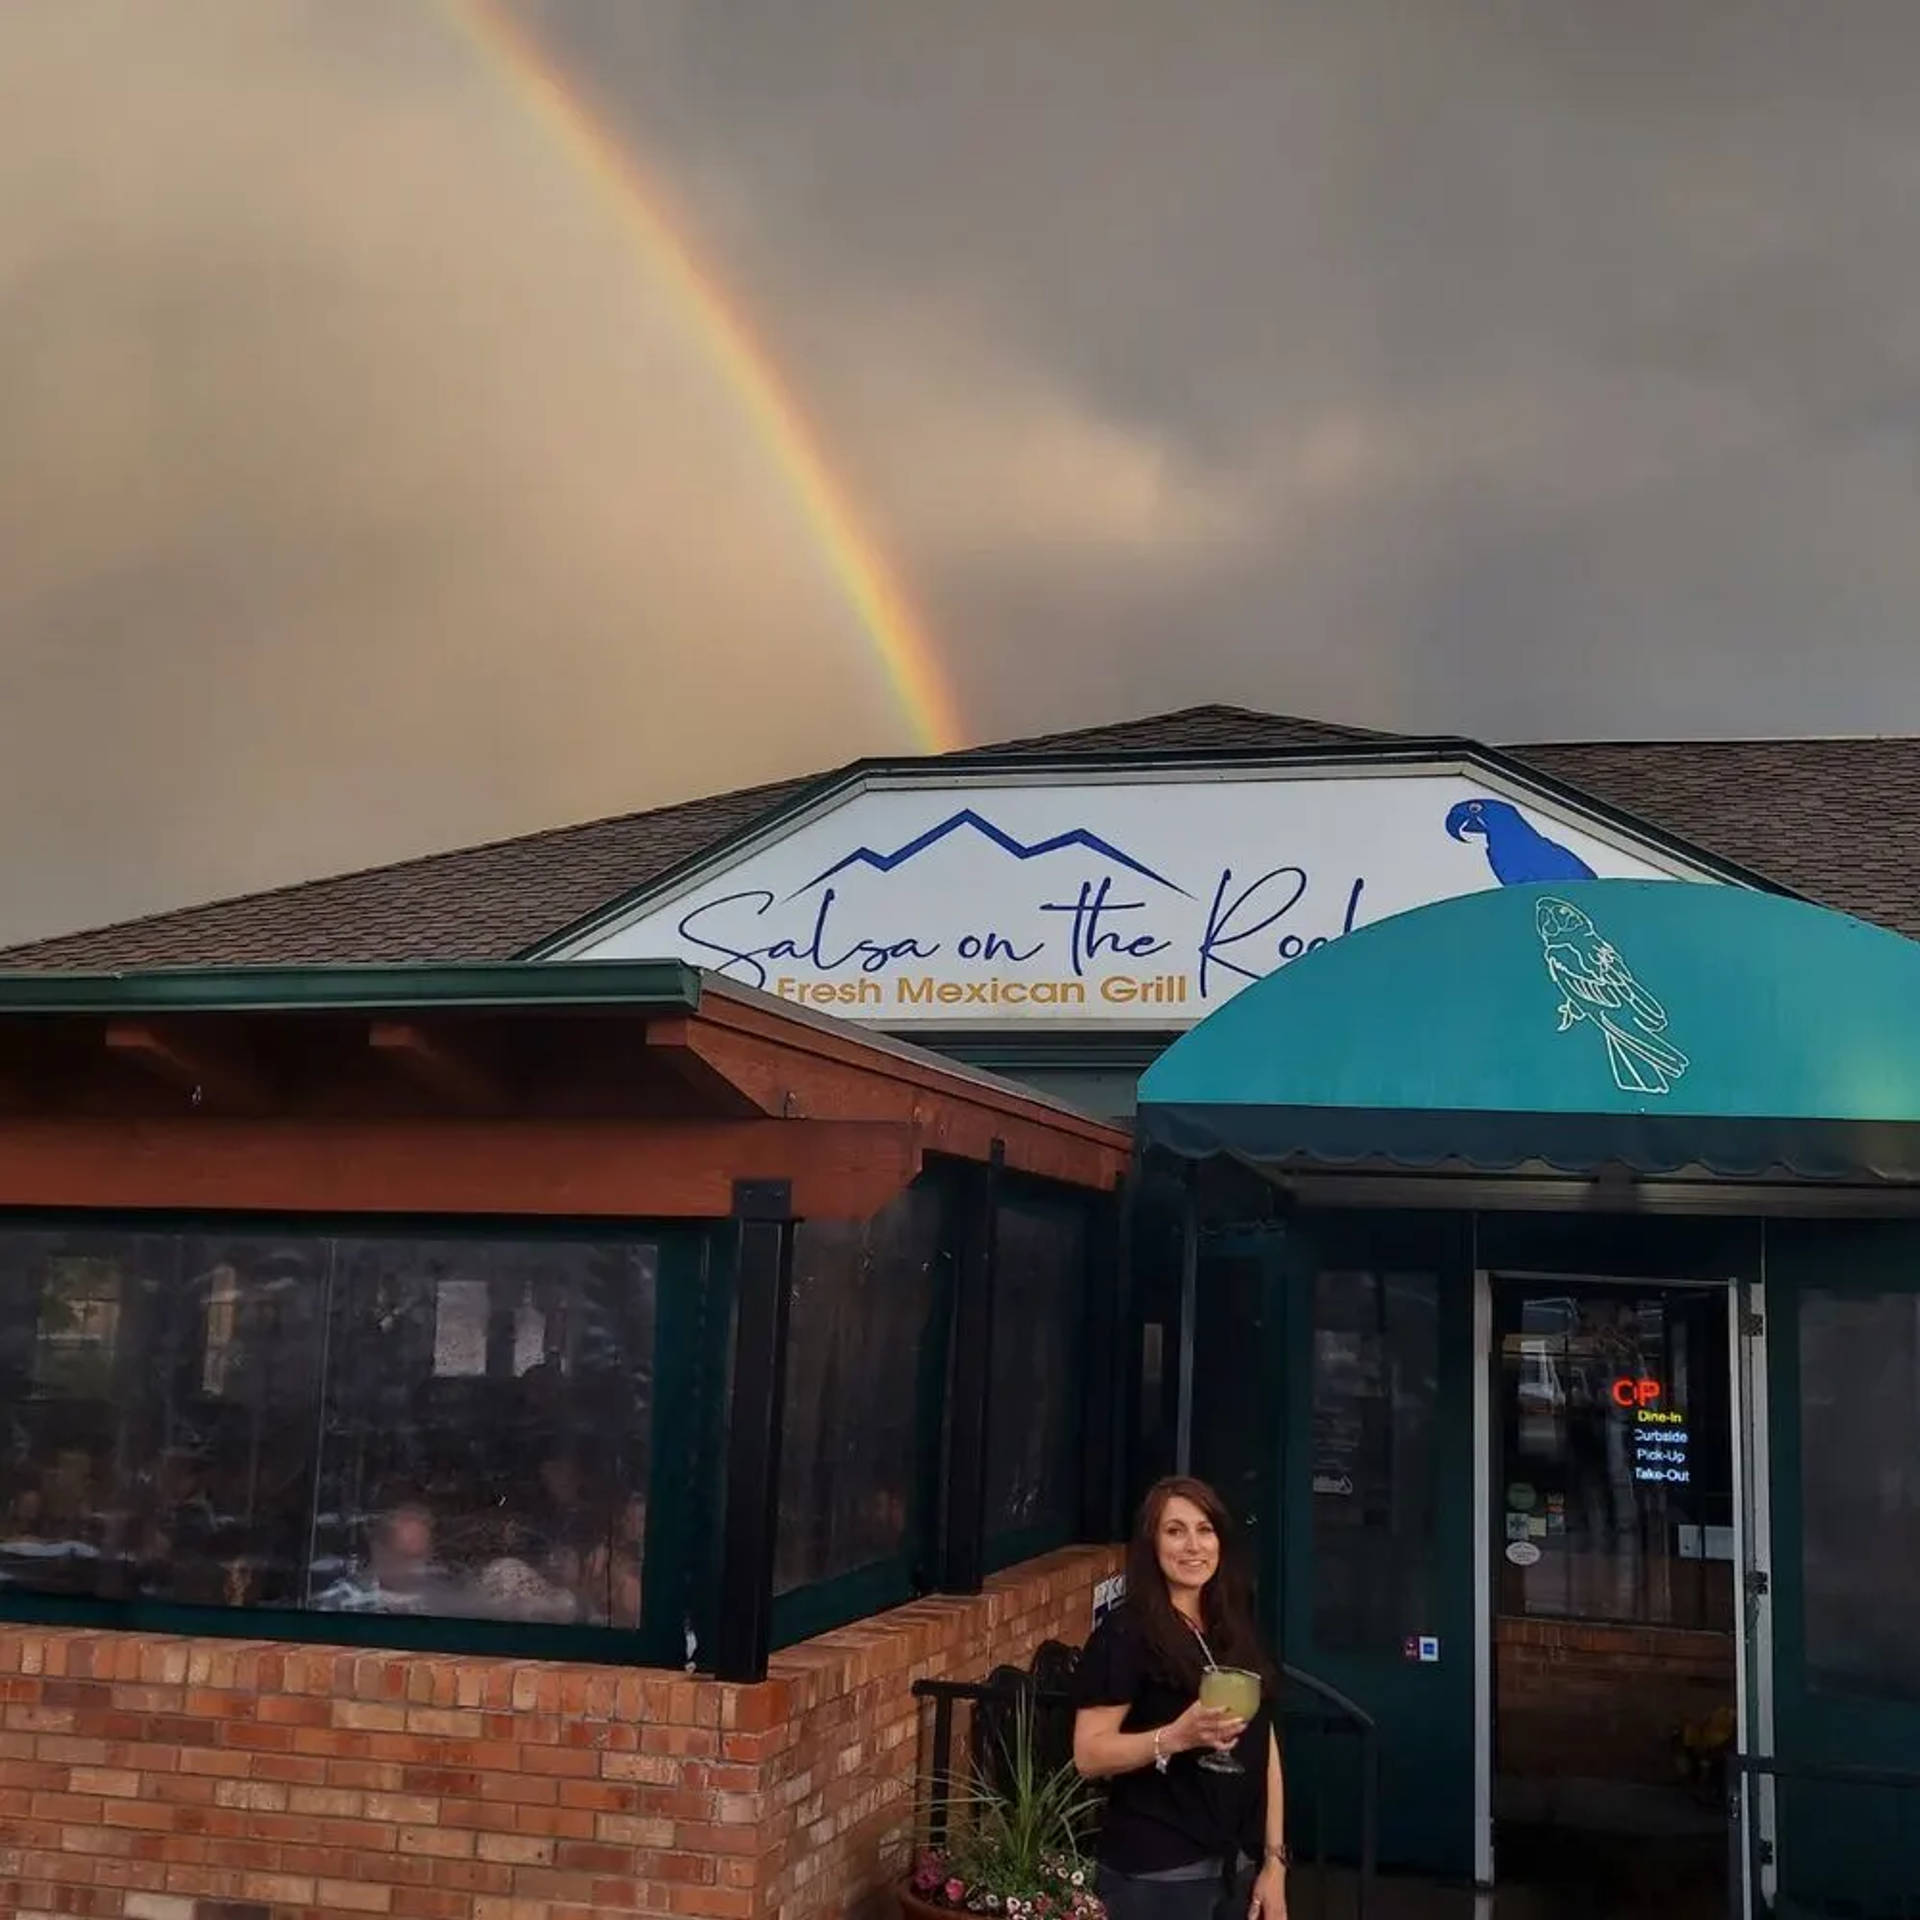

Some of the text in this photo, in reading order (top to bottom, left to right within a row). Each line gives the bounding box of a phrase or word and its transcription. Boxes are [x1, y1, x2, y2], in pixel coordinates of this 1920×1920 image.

[677, 887, 941, 989] Salsa
[957, 932, 1045, 962] on
[1039, 876, 1172, 977] the
[776, 975, 1187, 1004] Fresh Mexican Grill
